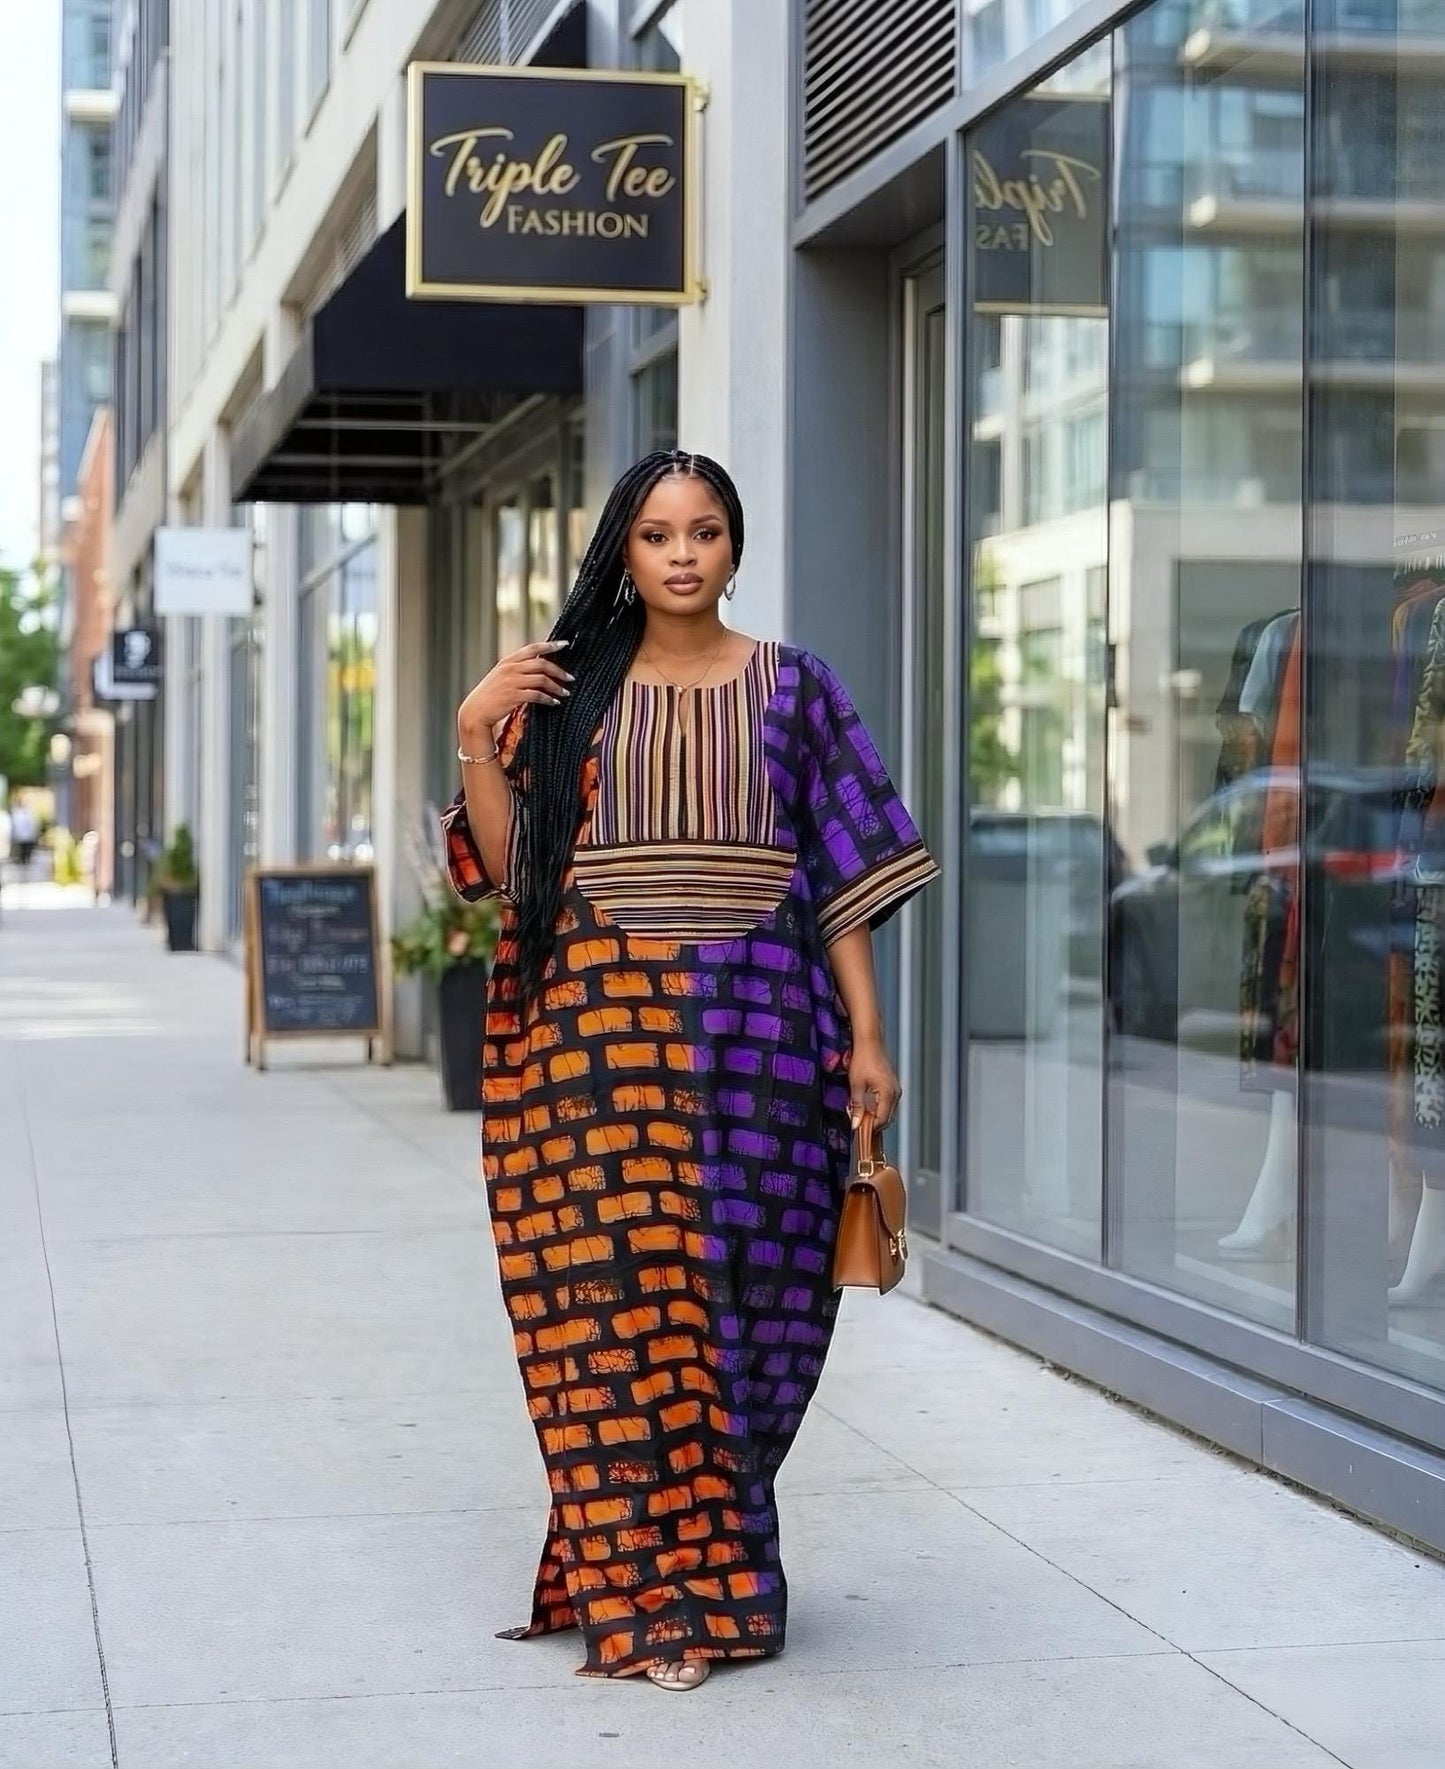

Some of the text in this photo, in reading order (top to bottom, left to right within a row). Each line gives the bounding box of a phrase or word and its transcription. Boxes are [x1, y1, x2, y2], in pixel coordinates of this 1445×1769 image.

[430, 127, 676, 228] Triple Tee
[507, 205, 649, 239] FASHION
